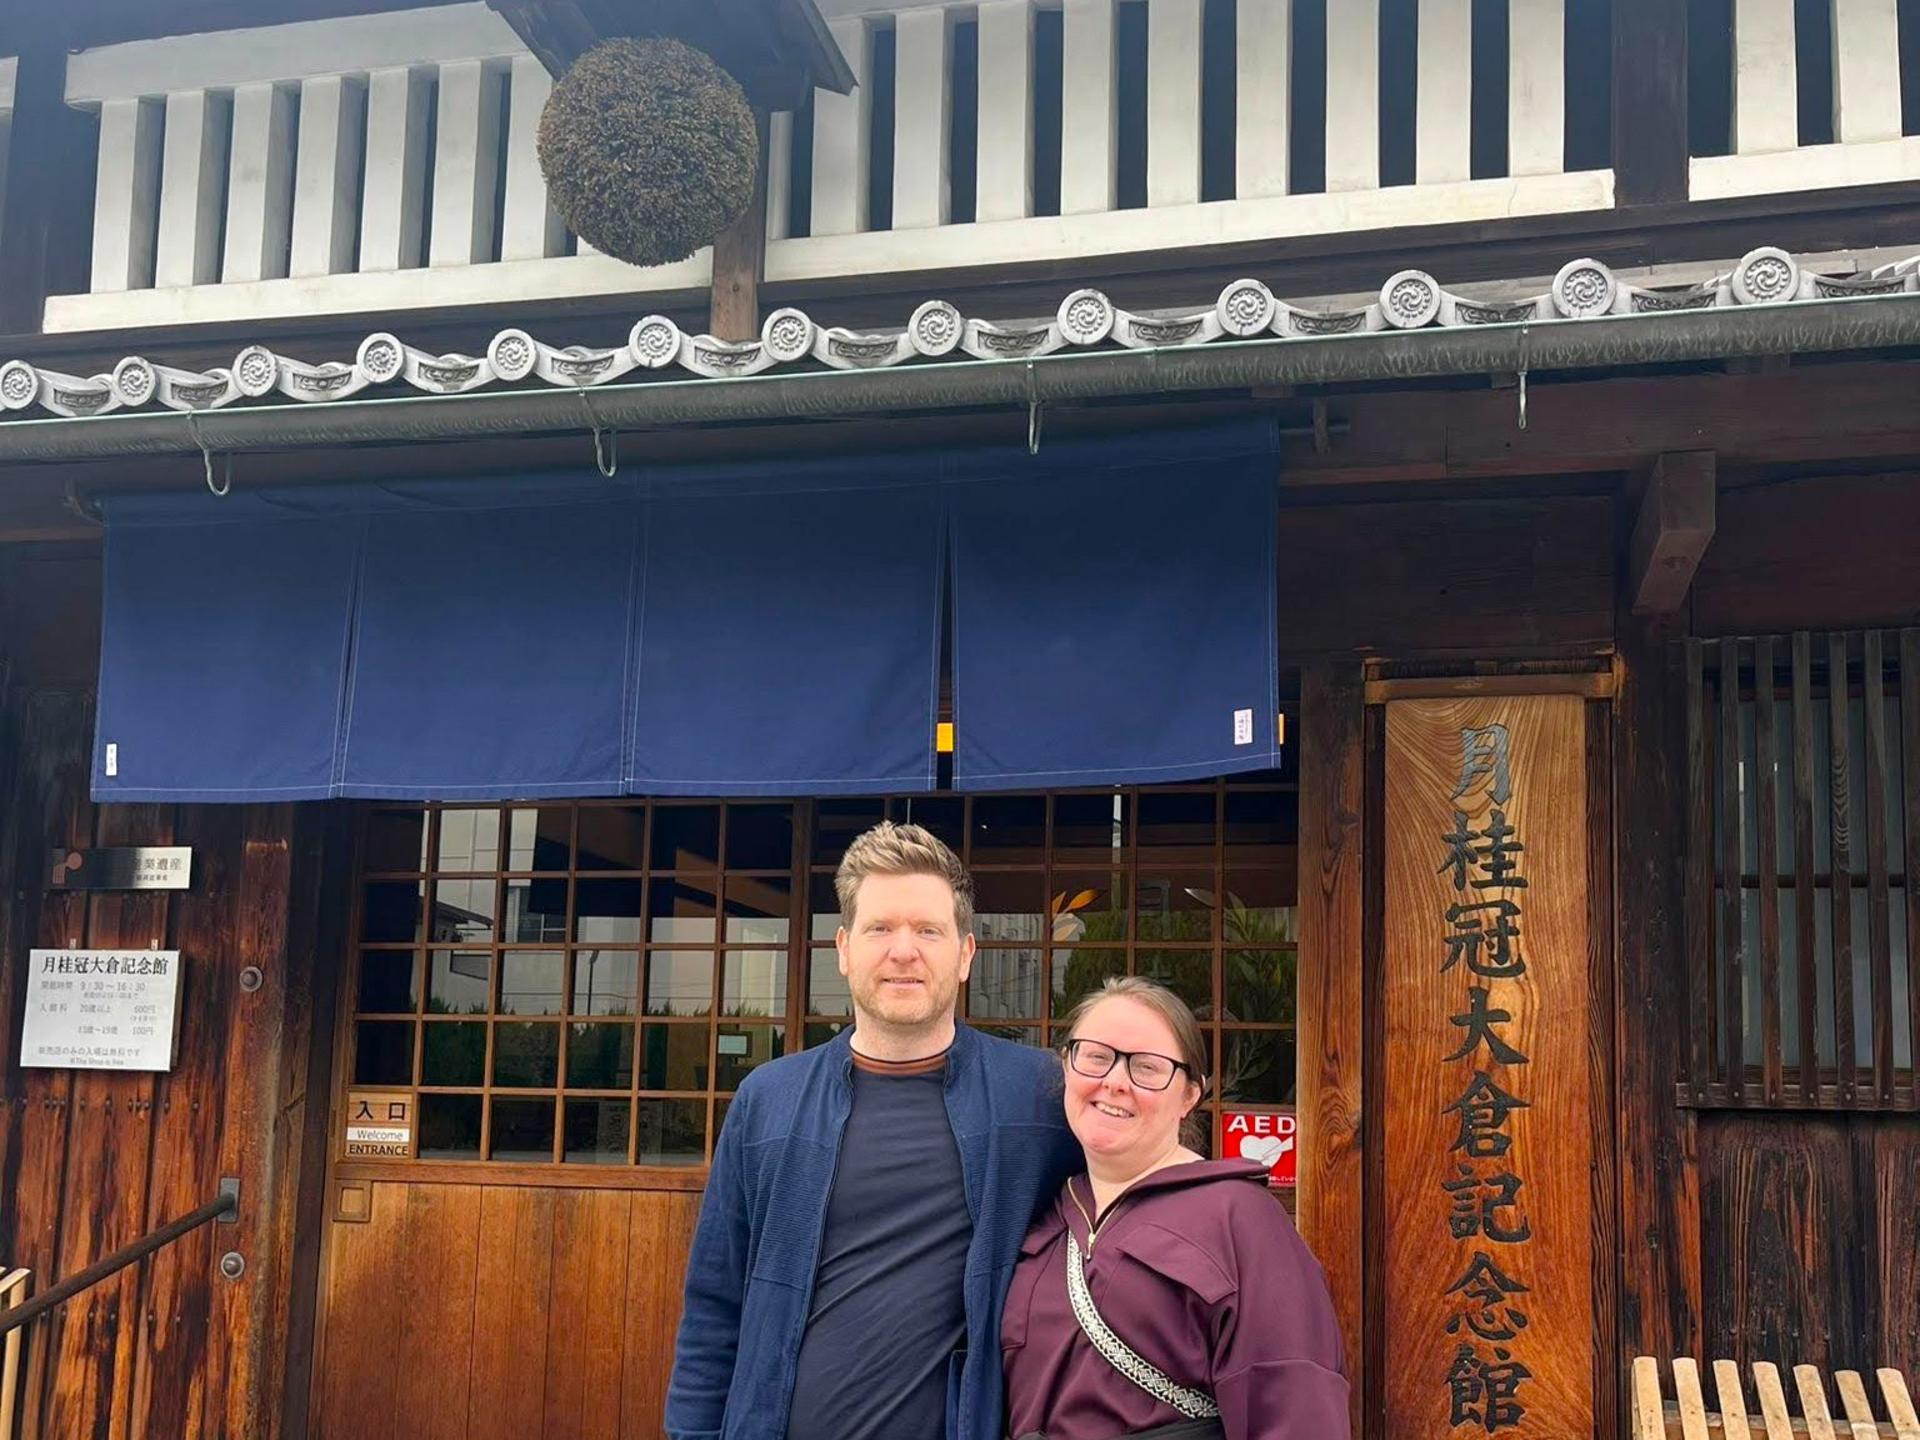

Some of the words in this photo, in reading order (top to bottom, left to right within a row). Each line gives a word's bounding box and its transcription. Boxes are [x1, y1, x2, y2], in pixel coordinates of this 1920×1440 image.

[41, 956, 169, 975] 月桂冠大倉記念館
[1437, 723, 1533, 1434] 月桂冠大倉記念館
[356, 1101, 406, 1120] 入口
[1227, 1115, 1296, 1134] AED
[357, 1130, 403, 1139] Welcome
[349, 1144, 409, 1156] ENTRANCE
